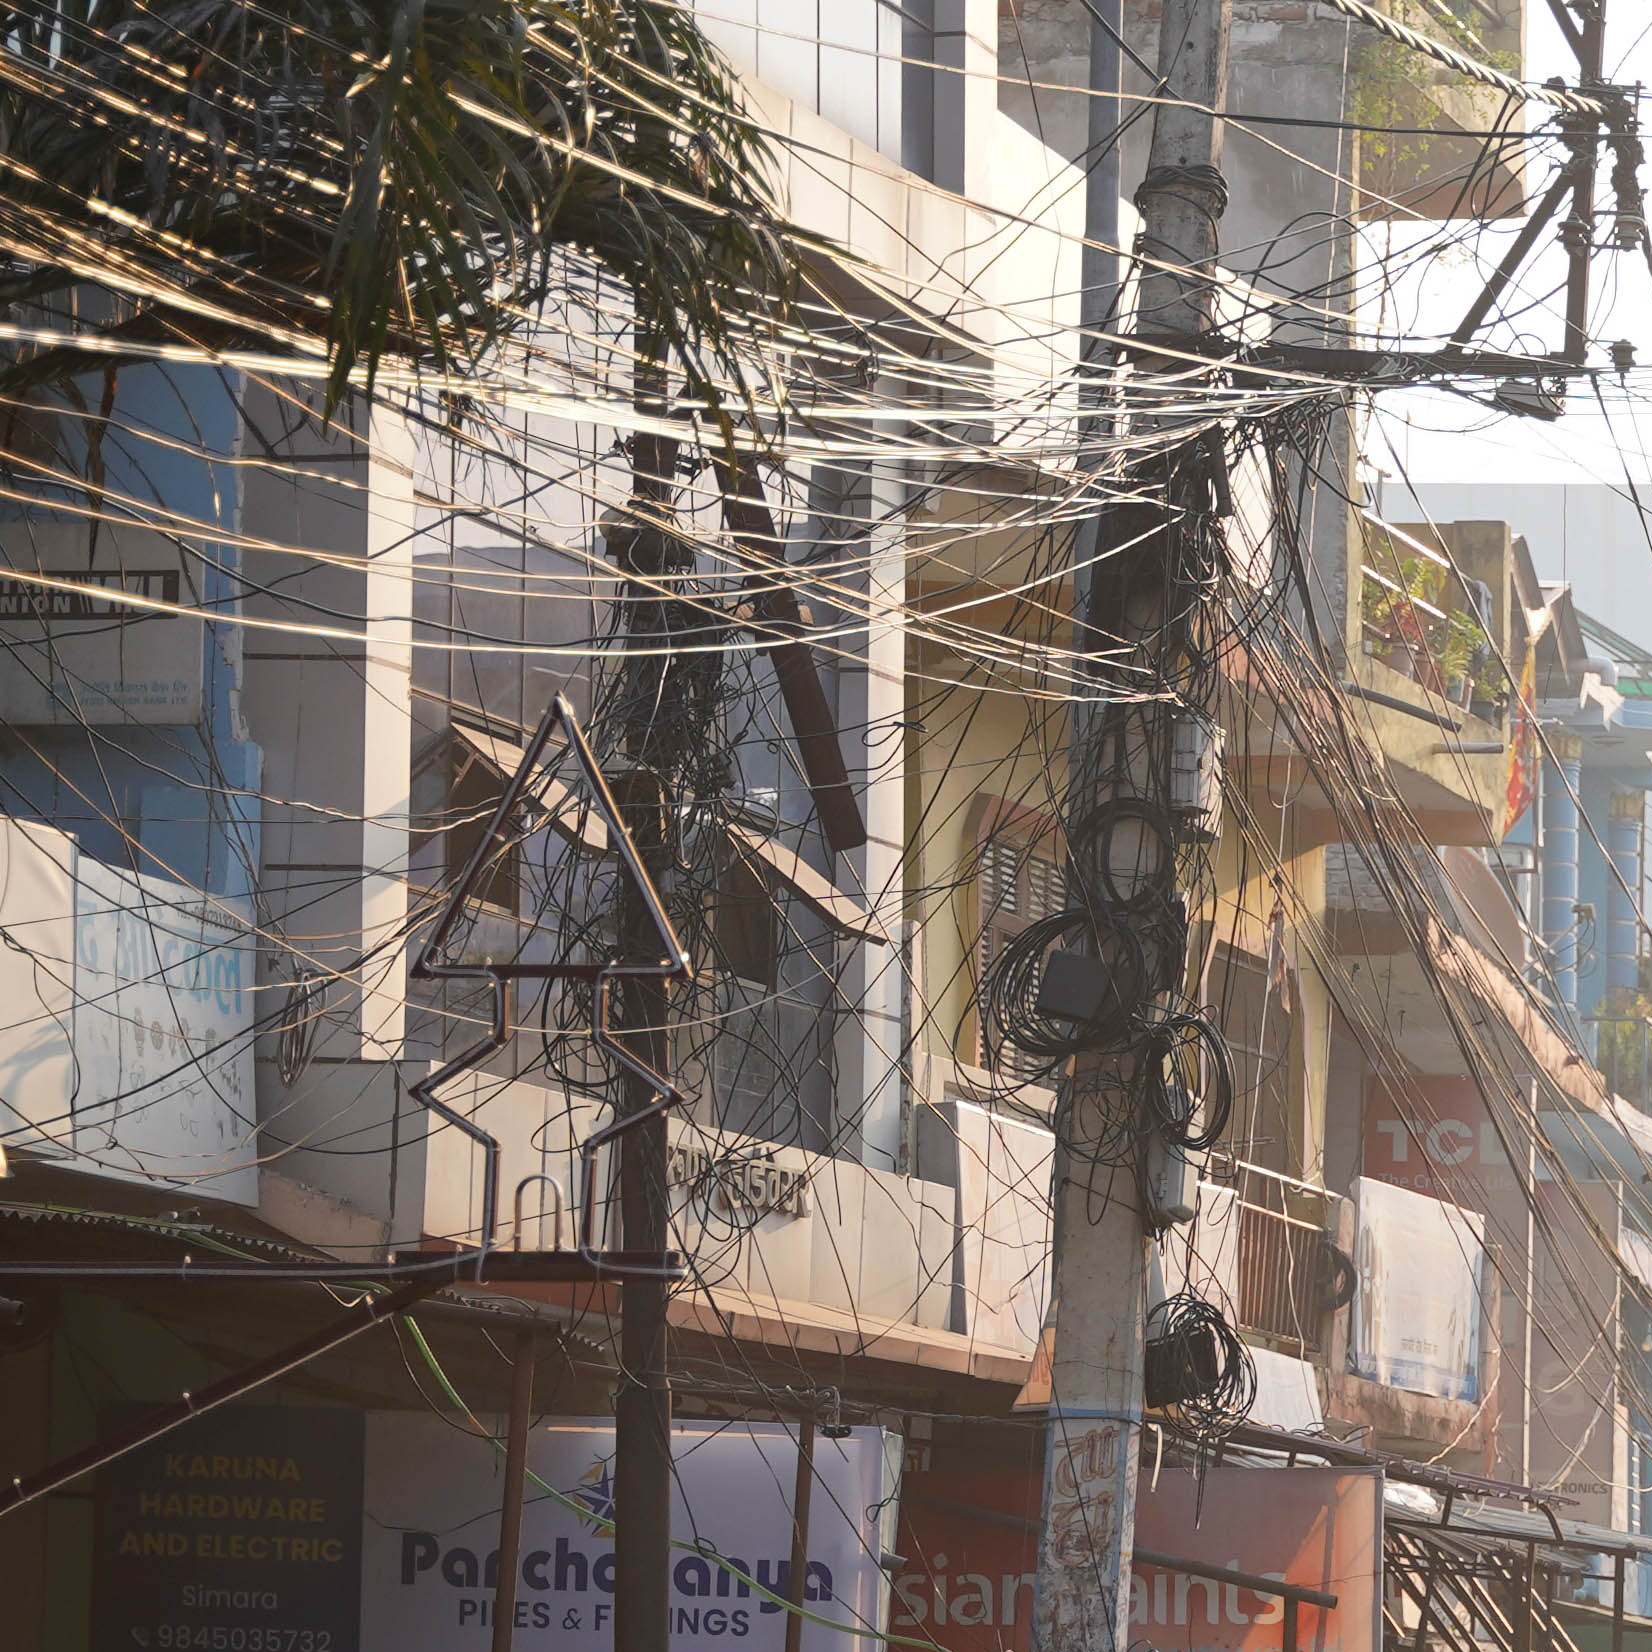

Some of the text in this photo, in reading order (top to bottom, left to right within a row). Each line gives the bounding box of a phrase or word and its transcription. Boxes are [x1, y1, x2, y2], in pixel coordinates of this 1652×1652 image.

[0, 595, 72, 615] NION
[1376, 1119, 1507, 1165] TCL
[165, 1455, 302, 1482] KARUNA
[139, 1491, 327, 1523] HARDWARE
[119, 1530, 344, 1562] AND ELECTRIC
[401, 1531, 833, 1615] Pachaanya
[893, 1552, 1285, 1626] sian aints
[182, 1583, 279, 1610] Simara
[458, 1599, 750, 1637] PIES & FNGS
